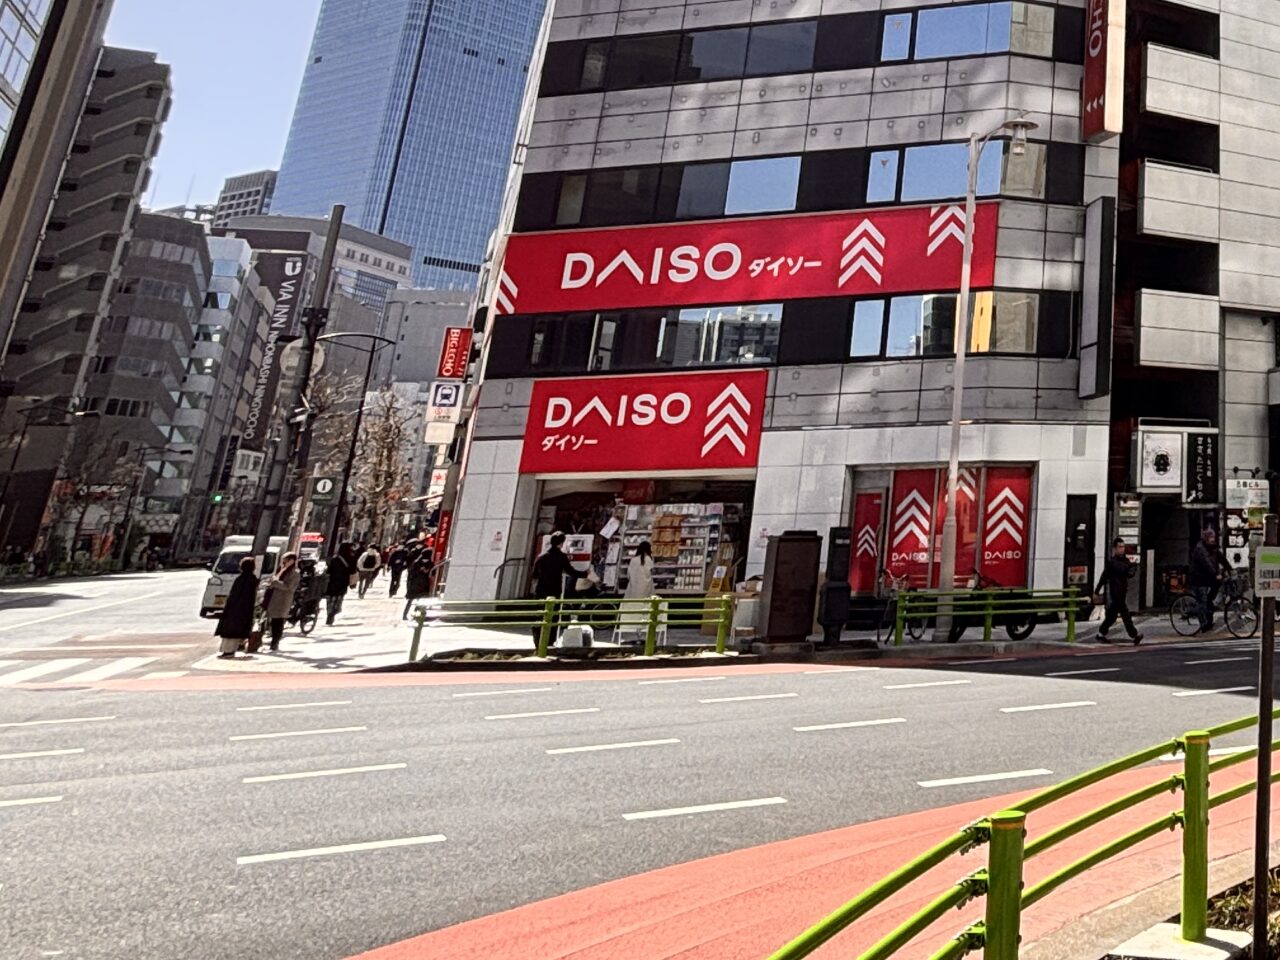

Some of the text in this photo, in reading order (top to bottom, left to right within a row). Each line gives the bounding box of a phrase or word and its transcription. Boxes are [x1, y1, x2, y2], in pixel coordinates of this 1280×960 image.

[560, 241, 743, 290] DAISO
[748, 255, 822, 279] ダイソー
[544, 391, 692, 429] DAISO
[541, 434, 598, 452] ダイソー
[892, 552, 930, 562] DAISO
[984, 550, 1022, 560] DAISO
